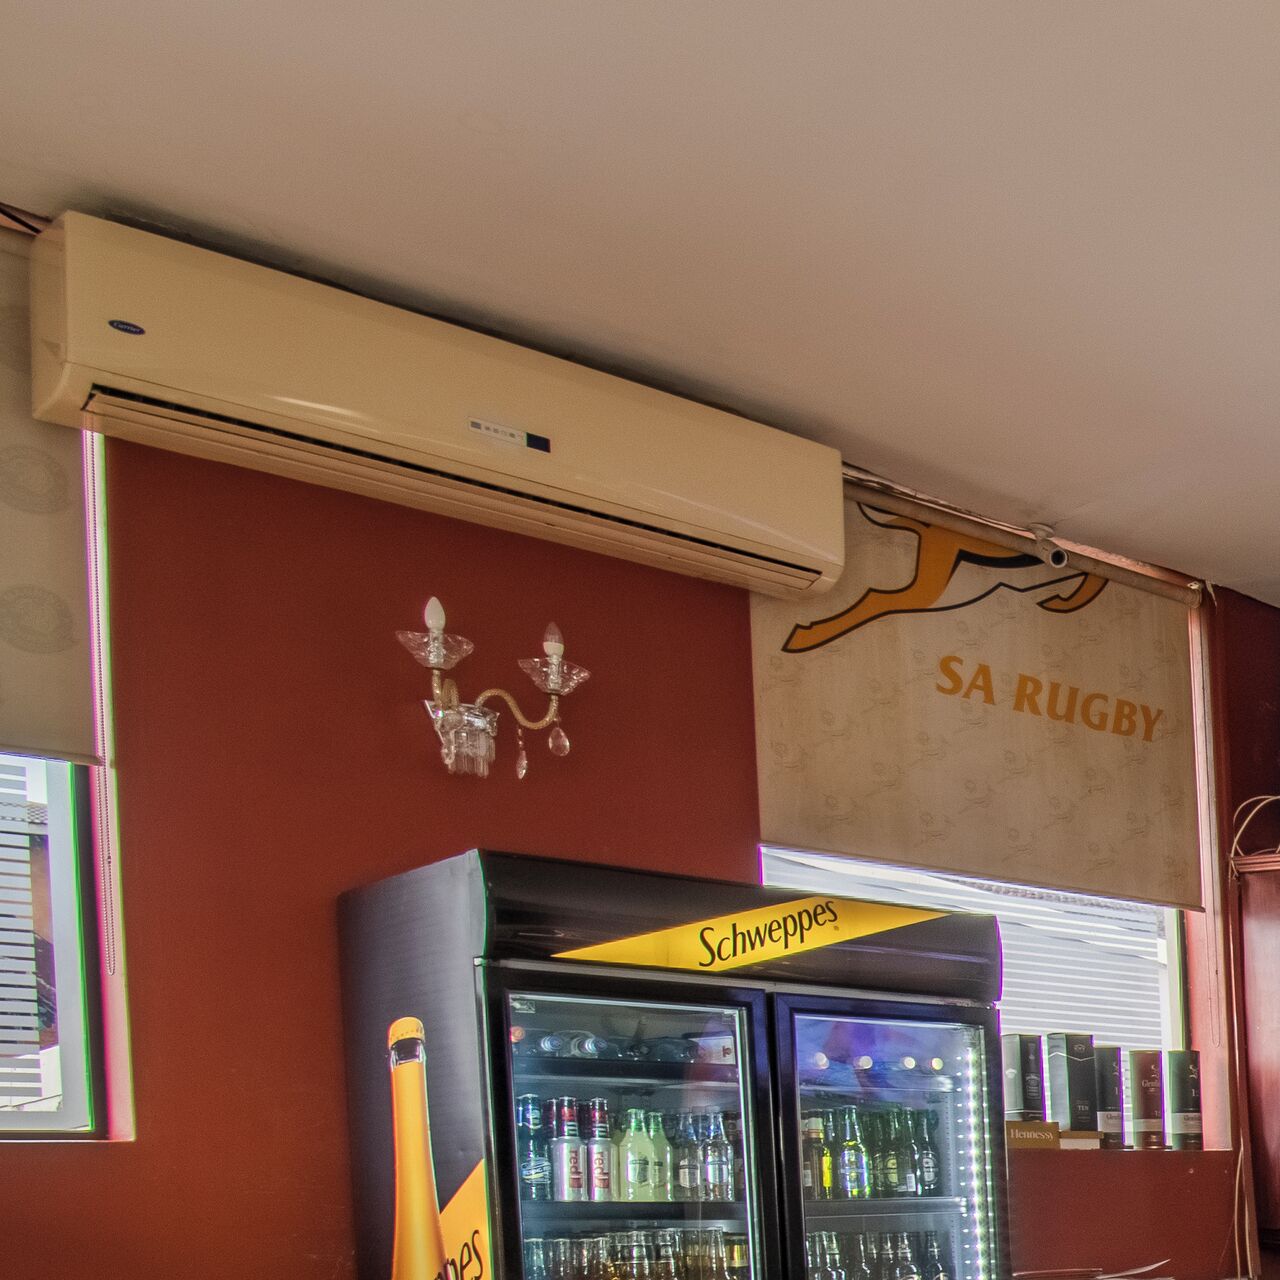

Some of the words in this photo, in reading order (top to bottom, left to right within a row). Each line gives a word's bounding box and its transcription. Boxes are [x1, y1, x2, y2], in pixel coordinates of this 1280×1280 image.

[936, 655, 996, 706] SA
[1012, 672, 1164, 742] RUGBY
[699, 900, 838, 967] Schweppes
[1010, 1128, 1053, 1141] Hennessy
